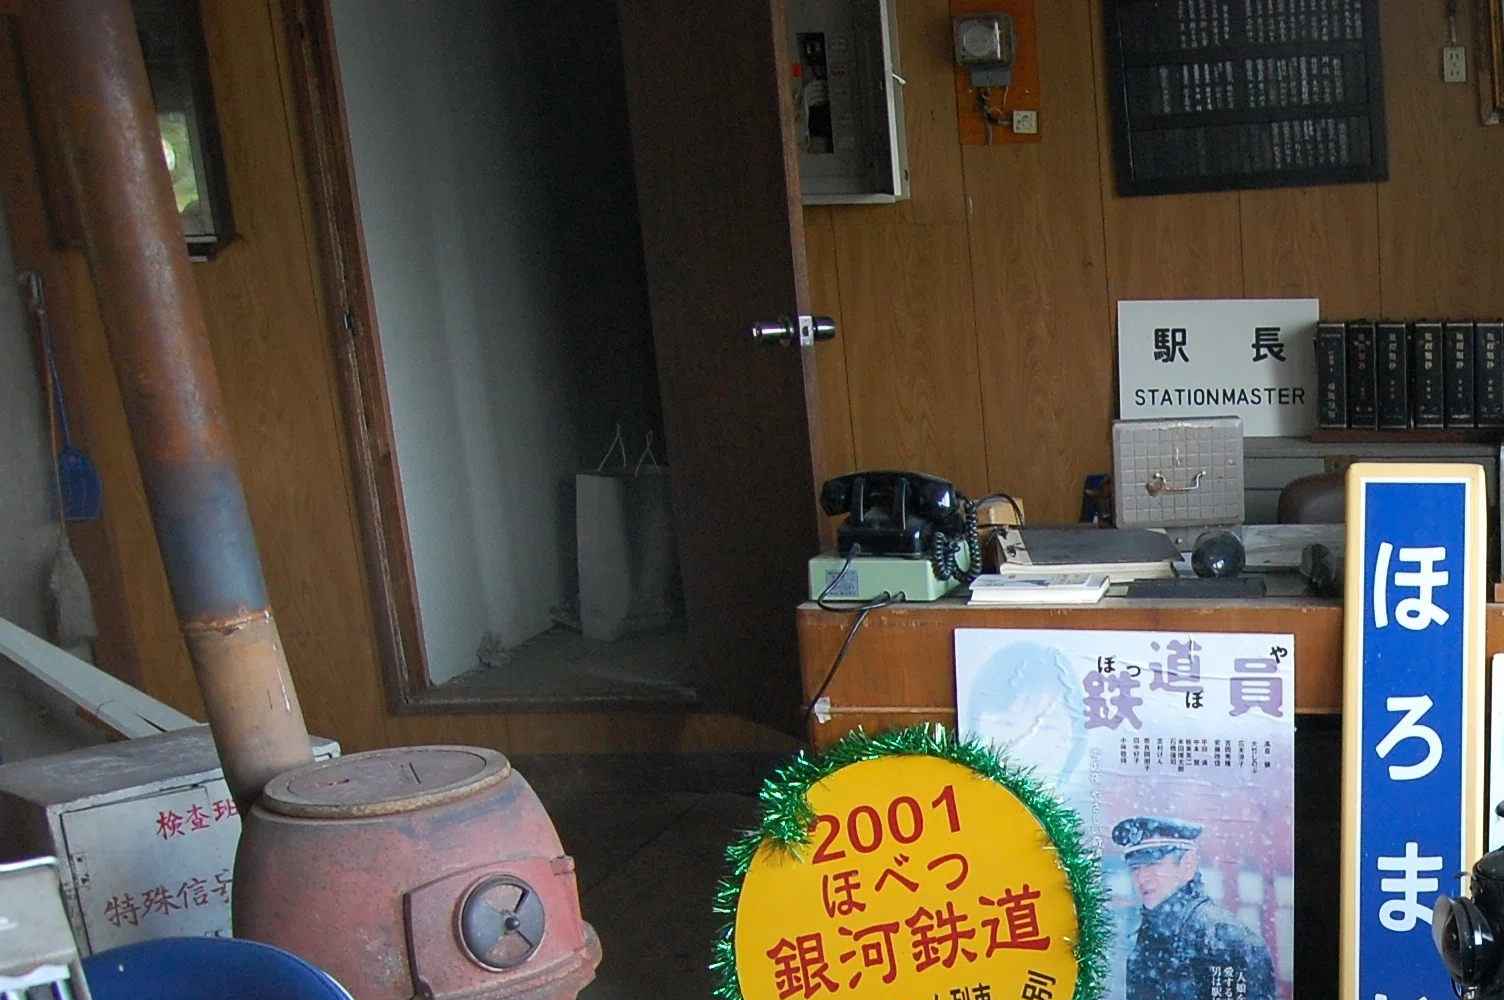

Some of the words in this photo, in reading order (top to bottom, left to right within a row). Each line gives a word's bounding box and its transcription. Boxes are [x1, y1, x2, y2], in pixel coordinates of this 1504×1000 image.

[1154, 327, 1287, 362] 駅長
[1135, 388, 1305, 406] STATIONMASTER
[1082, 639, 1283, 730] 鉄道員
[811, 785, 962, 864] 2001
[821, 852, 969, 918] ほべつ
[766, 883, 1051, 1000] 銀河鉄道
